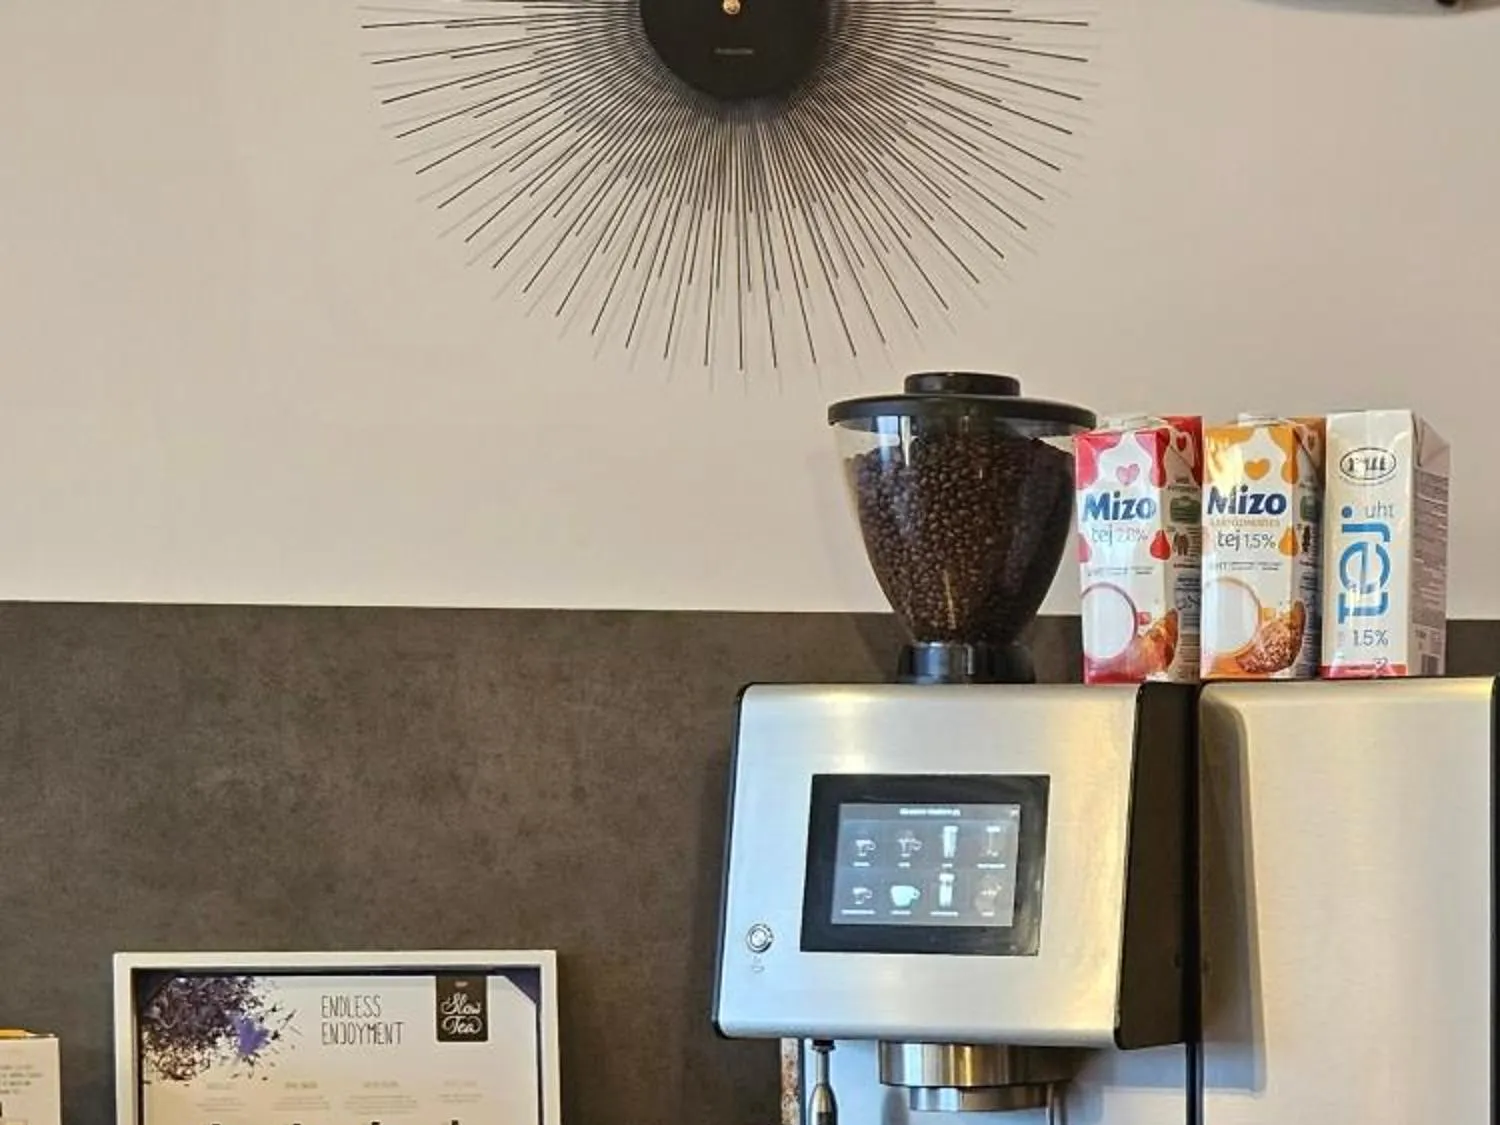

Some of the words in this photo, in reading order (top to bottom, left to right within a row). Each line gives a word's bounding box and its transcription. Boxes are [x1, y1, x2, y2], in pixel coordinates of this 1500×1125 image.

[1082, 490, 1157, 521] Mizo
[1207, 484, 1287, 515] Mizo
[1217, 529, 1241, 551] tej
[320, 994, 383, 1019] ENDLESS
[320, 1021, 405, 1046] ENJOYMENT
[442, 1016, 483, 1035] Tea
